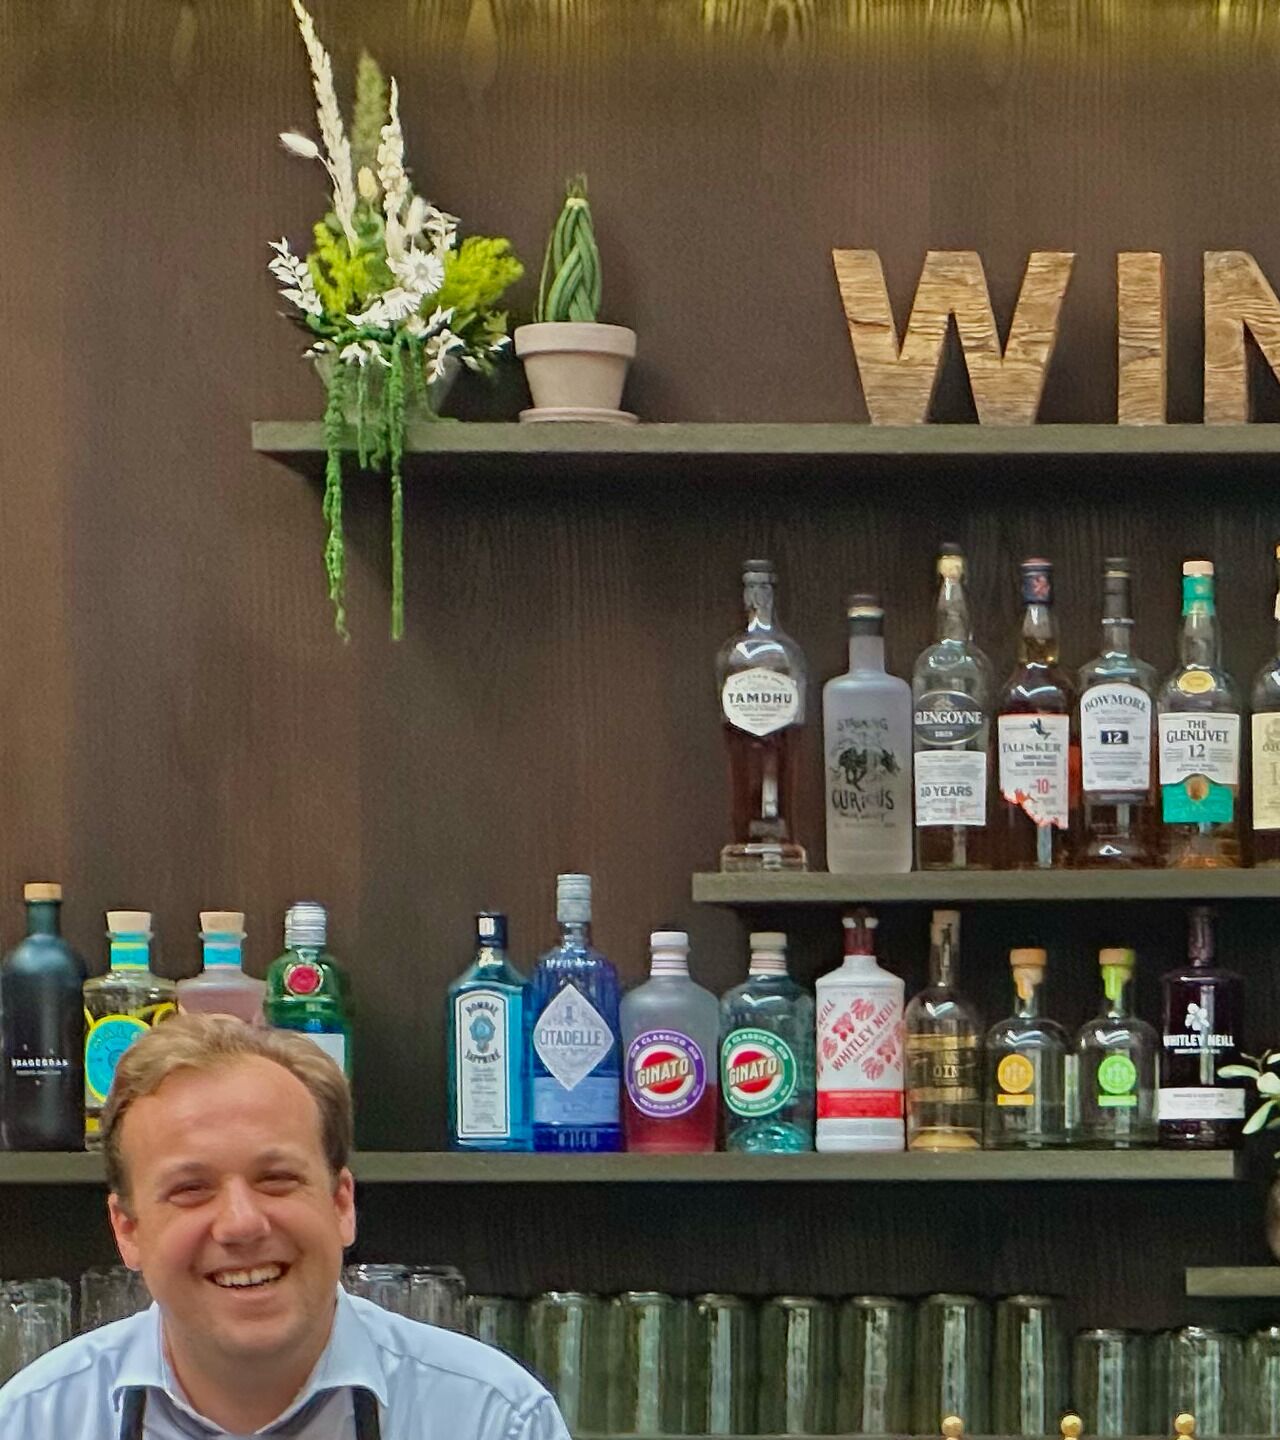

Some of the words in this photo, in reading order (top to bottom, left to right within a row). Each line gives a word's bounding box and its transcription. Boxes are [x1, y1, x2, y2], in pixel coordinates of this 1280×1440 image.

[727, 692, 793, 705] TAMDHU
[1084, 694, 1147, 713] BOWMORE
[914, 711, 982, 725] GLENGOYNE
[1186, 719, 1207, 729] THE
[1105, 731, 1123, 744] 12
[1166, 730, 1229, 744] GLENLIVET
[1002, 742, 1062, 754] TALISKER
[1188, 744, 1206, 758] 12
[933, 785, 973, 798] YEARS
[1036, 778, 1049, 794] 10
[539, 1029, 603, 1047] CITADELLE
[1162, 1034, 1203, 1048] WHITLEY
[1207, 1034, 1236, 1047] NEILL
[831, 1025, 876, 1072] WHITLEY
[636, 1056, 690, 1088] GINATO
[727, 1056, 778, 1088] GINATO
